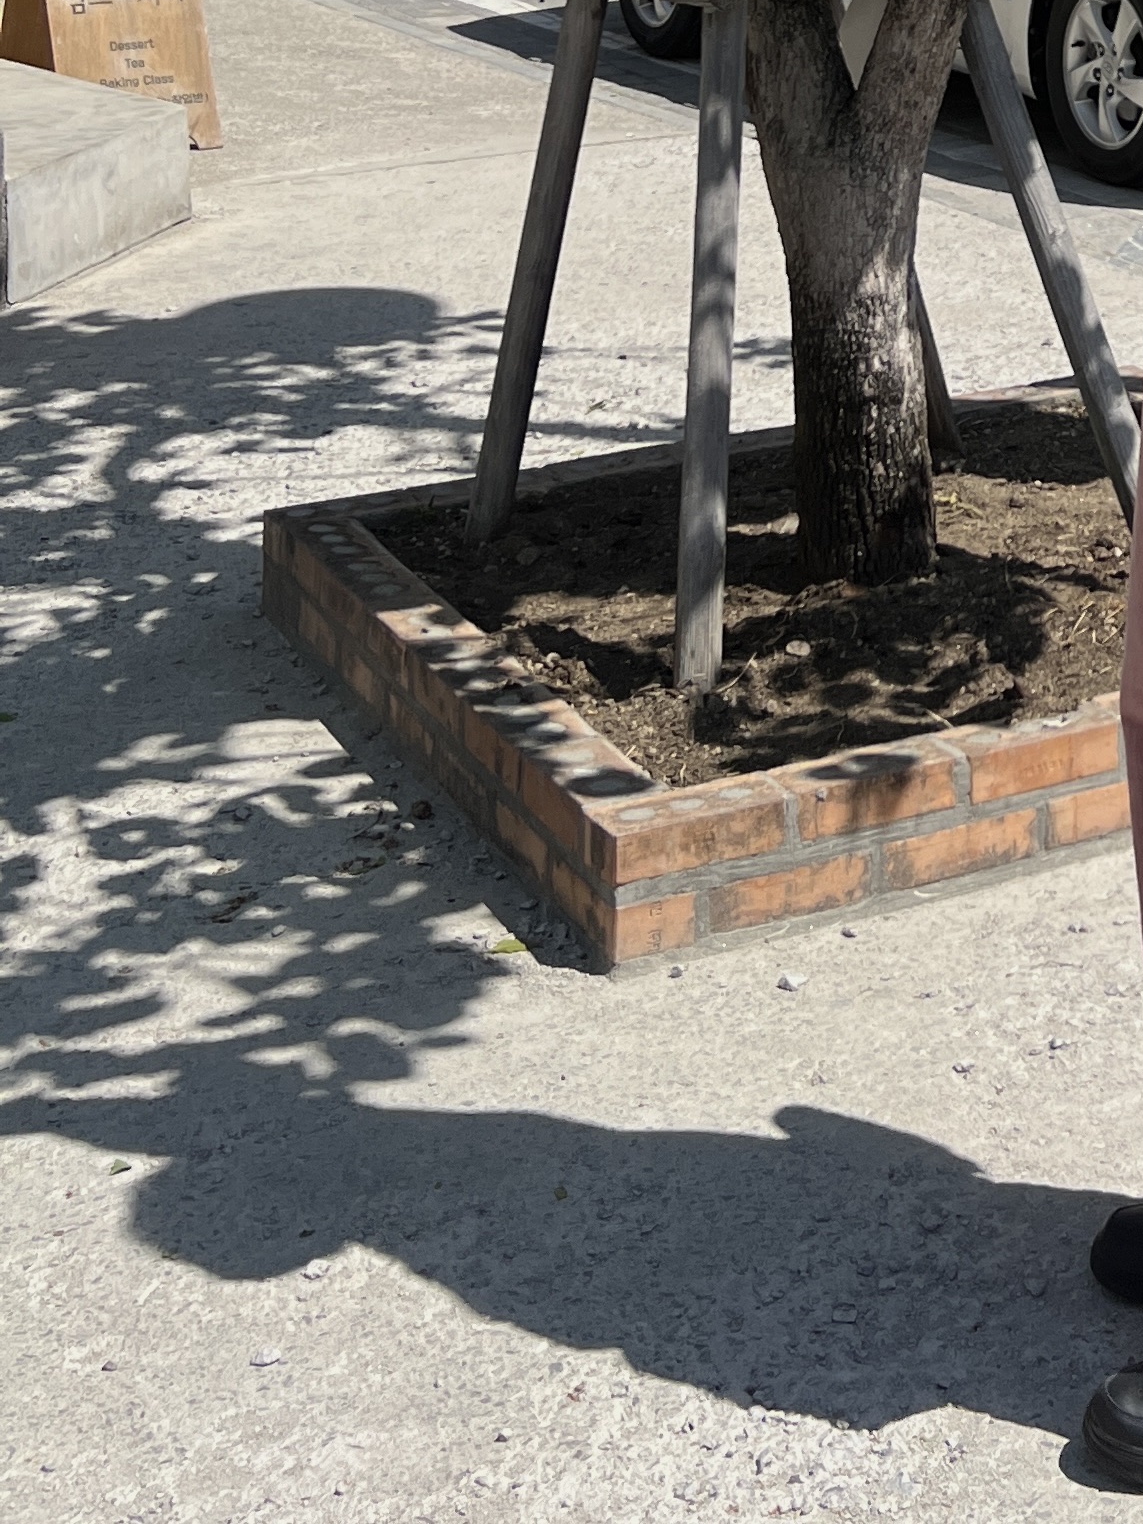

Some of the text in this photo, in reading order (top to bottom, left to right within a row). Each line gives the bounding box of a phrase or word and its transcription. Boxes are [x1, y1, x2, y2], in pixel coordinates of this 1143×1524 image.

[109, 38, 155, 52] Dessert
[124, 58, 146, 69] Tea
[143, 75, 175, 87] Class
